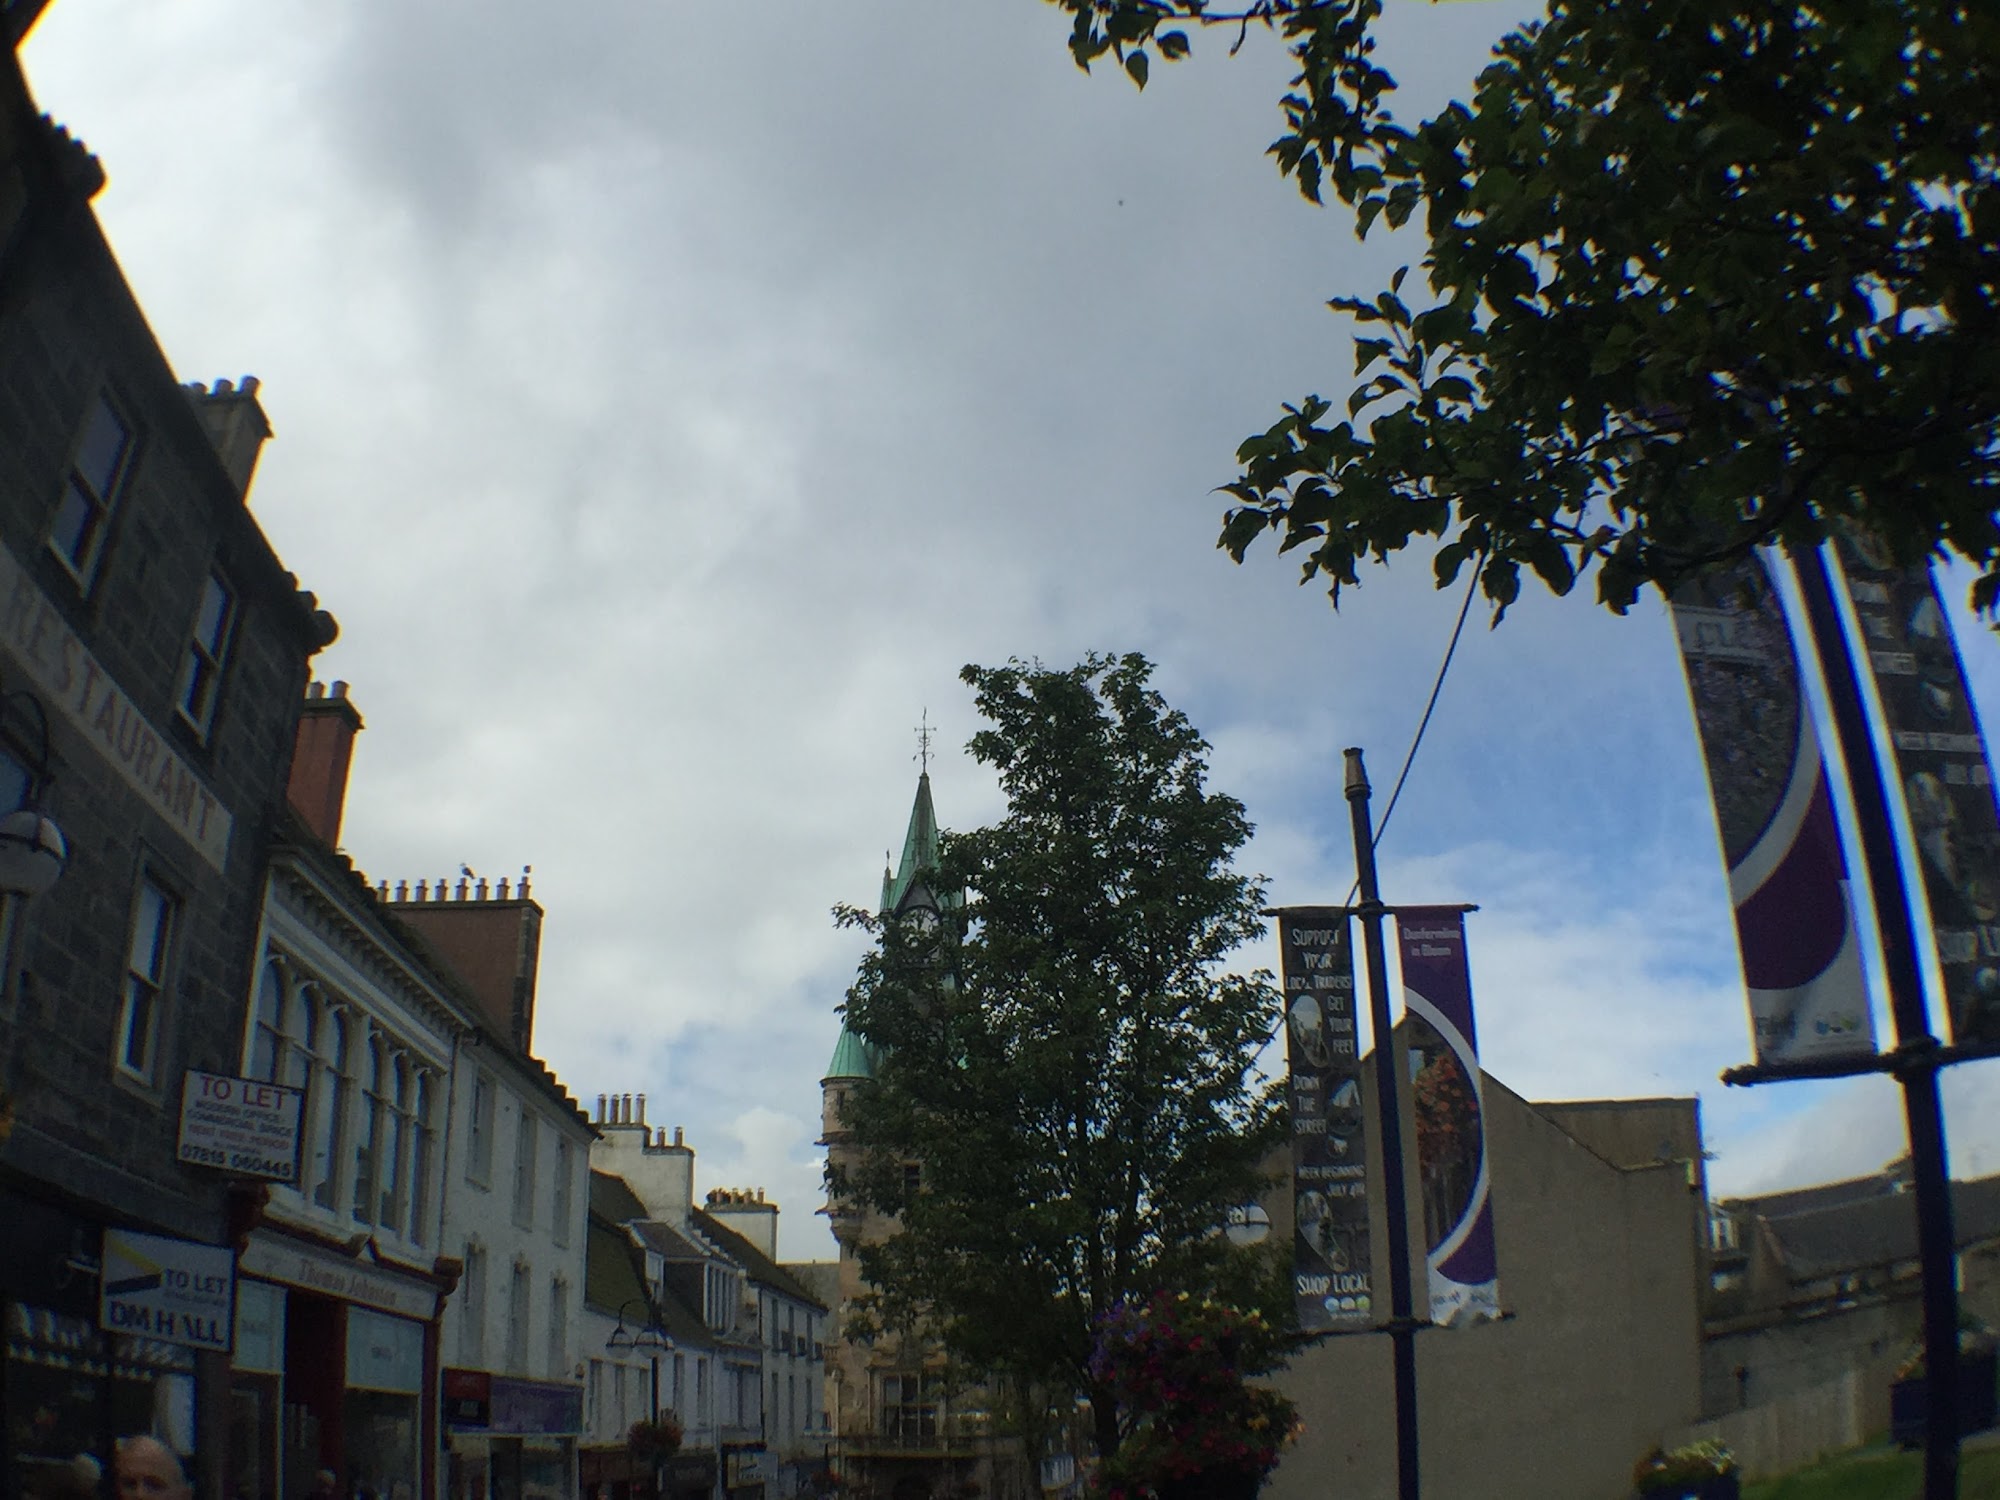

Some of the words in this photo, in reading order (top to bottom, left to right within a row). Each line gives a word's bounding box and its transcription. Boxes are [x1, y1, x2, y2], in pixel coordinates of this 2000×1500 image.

[8, 573, 217, 841] RESTAURANT
[1292, 928, 1339, 946] SUPPORT
[1302, 951, 1334, 969] YOUR
[1285, 975, 1313, 990] LOCAL
[1327, 994, 1344, 1011] GET
[1327, 1016, 1352, 1032] YOUR
[1333, 1039, 1354, 1054] FEET
[1293, 1074, 1320, 1091] DOWN
[201, 1075, 231, 1100] TO
[243, 1084, 288, 1110] LET
[1297, 1095, 1315, 1113] THE
[1295, 1119, 1327, 1134] STREET
[164, 1268, 190, 1288] TO
[194, 1273, 228, 1294] LET
[1297, 1273, 1330, 1296] SHOP
[1332, 1271, 1371, 1294] LOCAL
